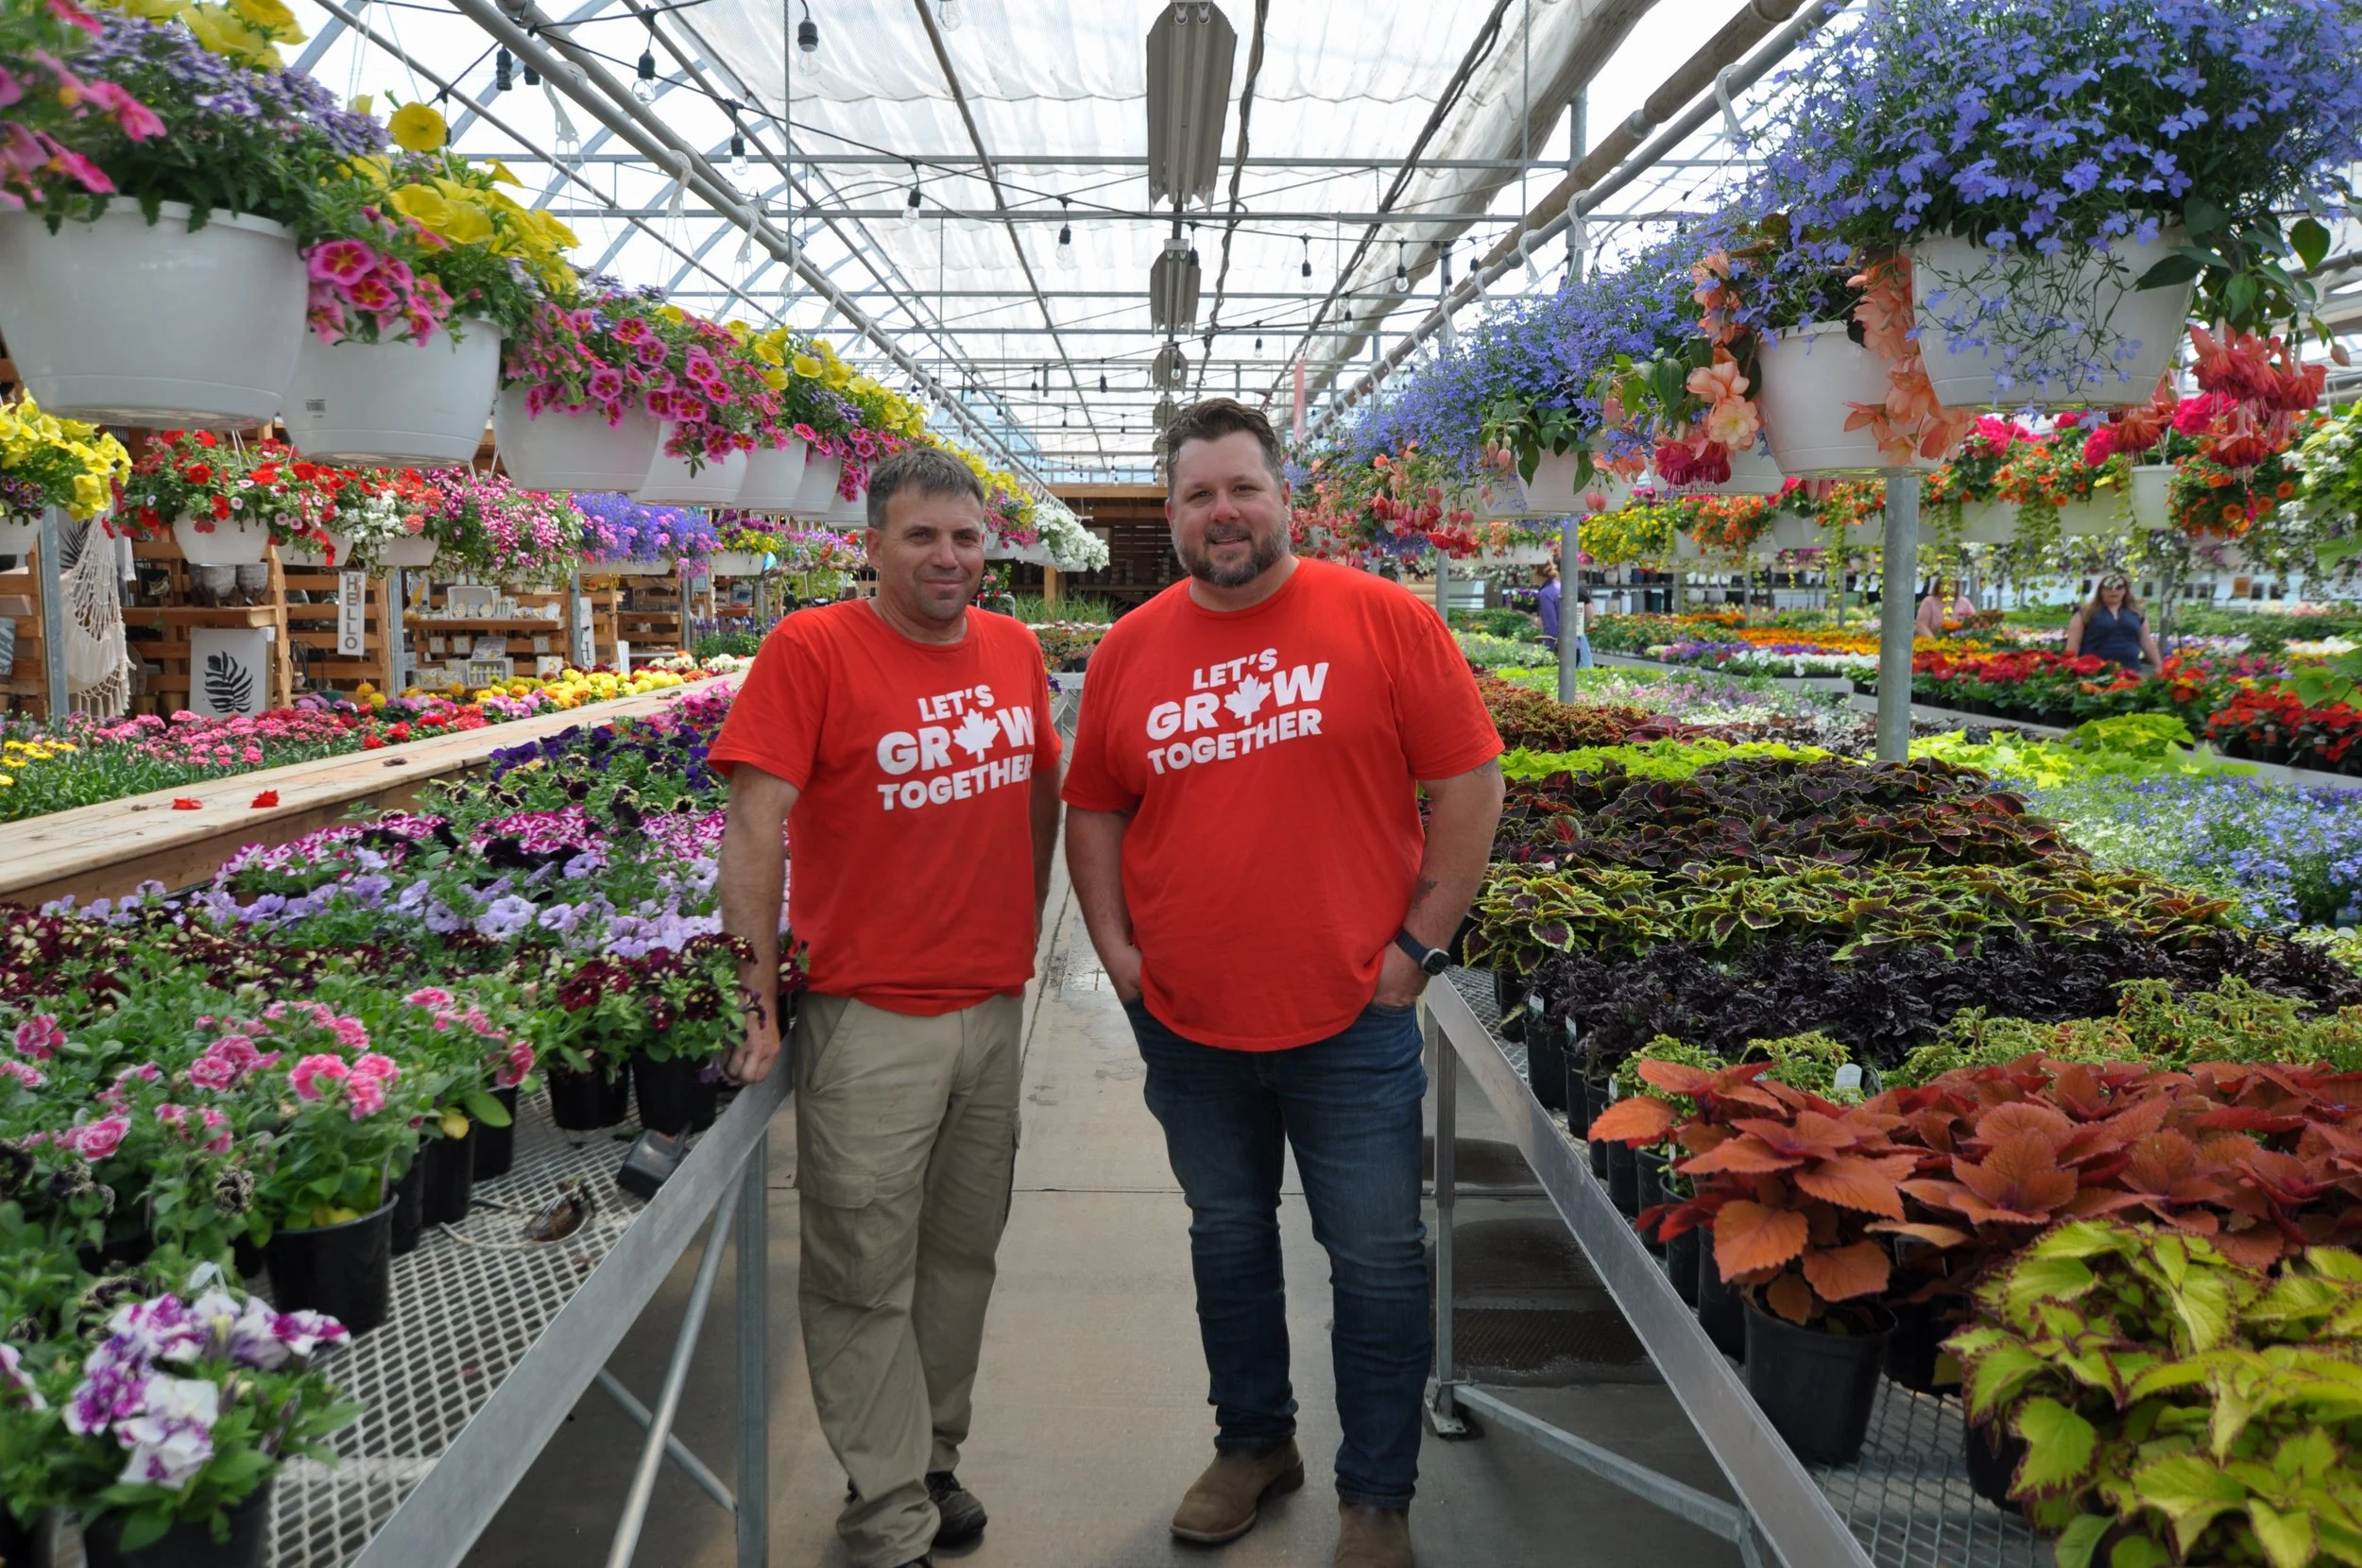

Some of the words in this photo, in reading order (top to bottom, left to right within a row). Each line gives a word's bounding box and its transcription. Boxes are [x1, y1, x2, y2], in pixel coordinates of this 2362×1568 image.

[344, 574, 358, 650] HELLO
[1146, 662, 1329, 741] GRW
[1192, 648, 1277, 690] LET'S
[917, 685, 995, 723] LET'S
[877, 706, 1036, 775] GRW
[1147, 708, 1322, 775] TOGETHER
[877, 754, 1033, 810] TOGETHER
